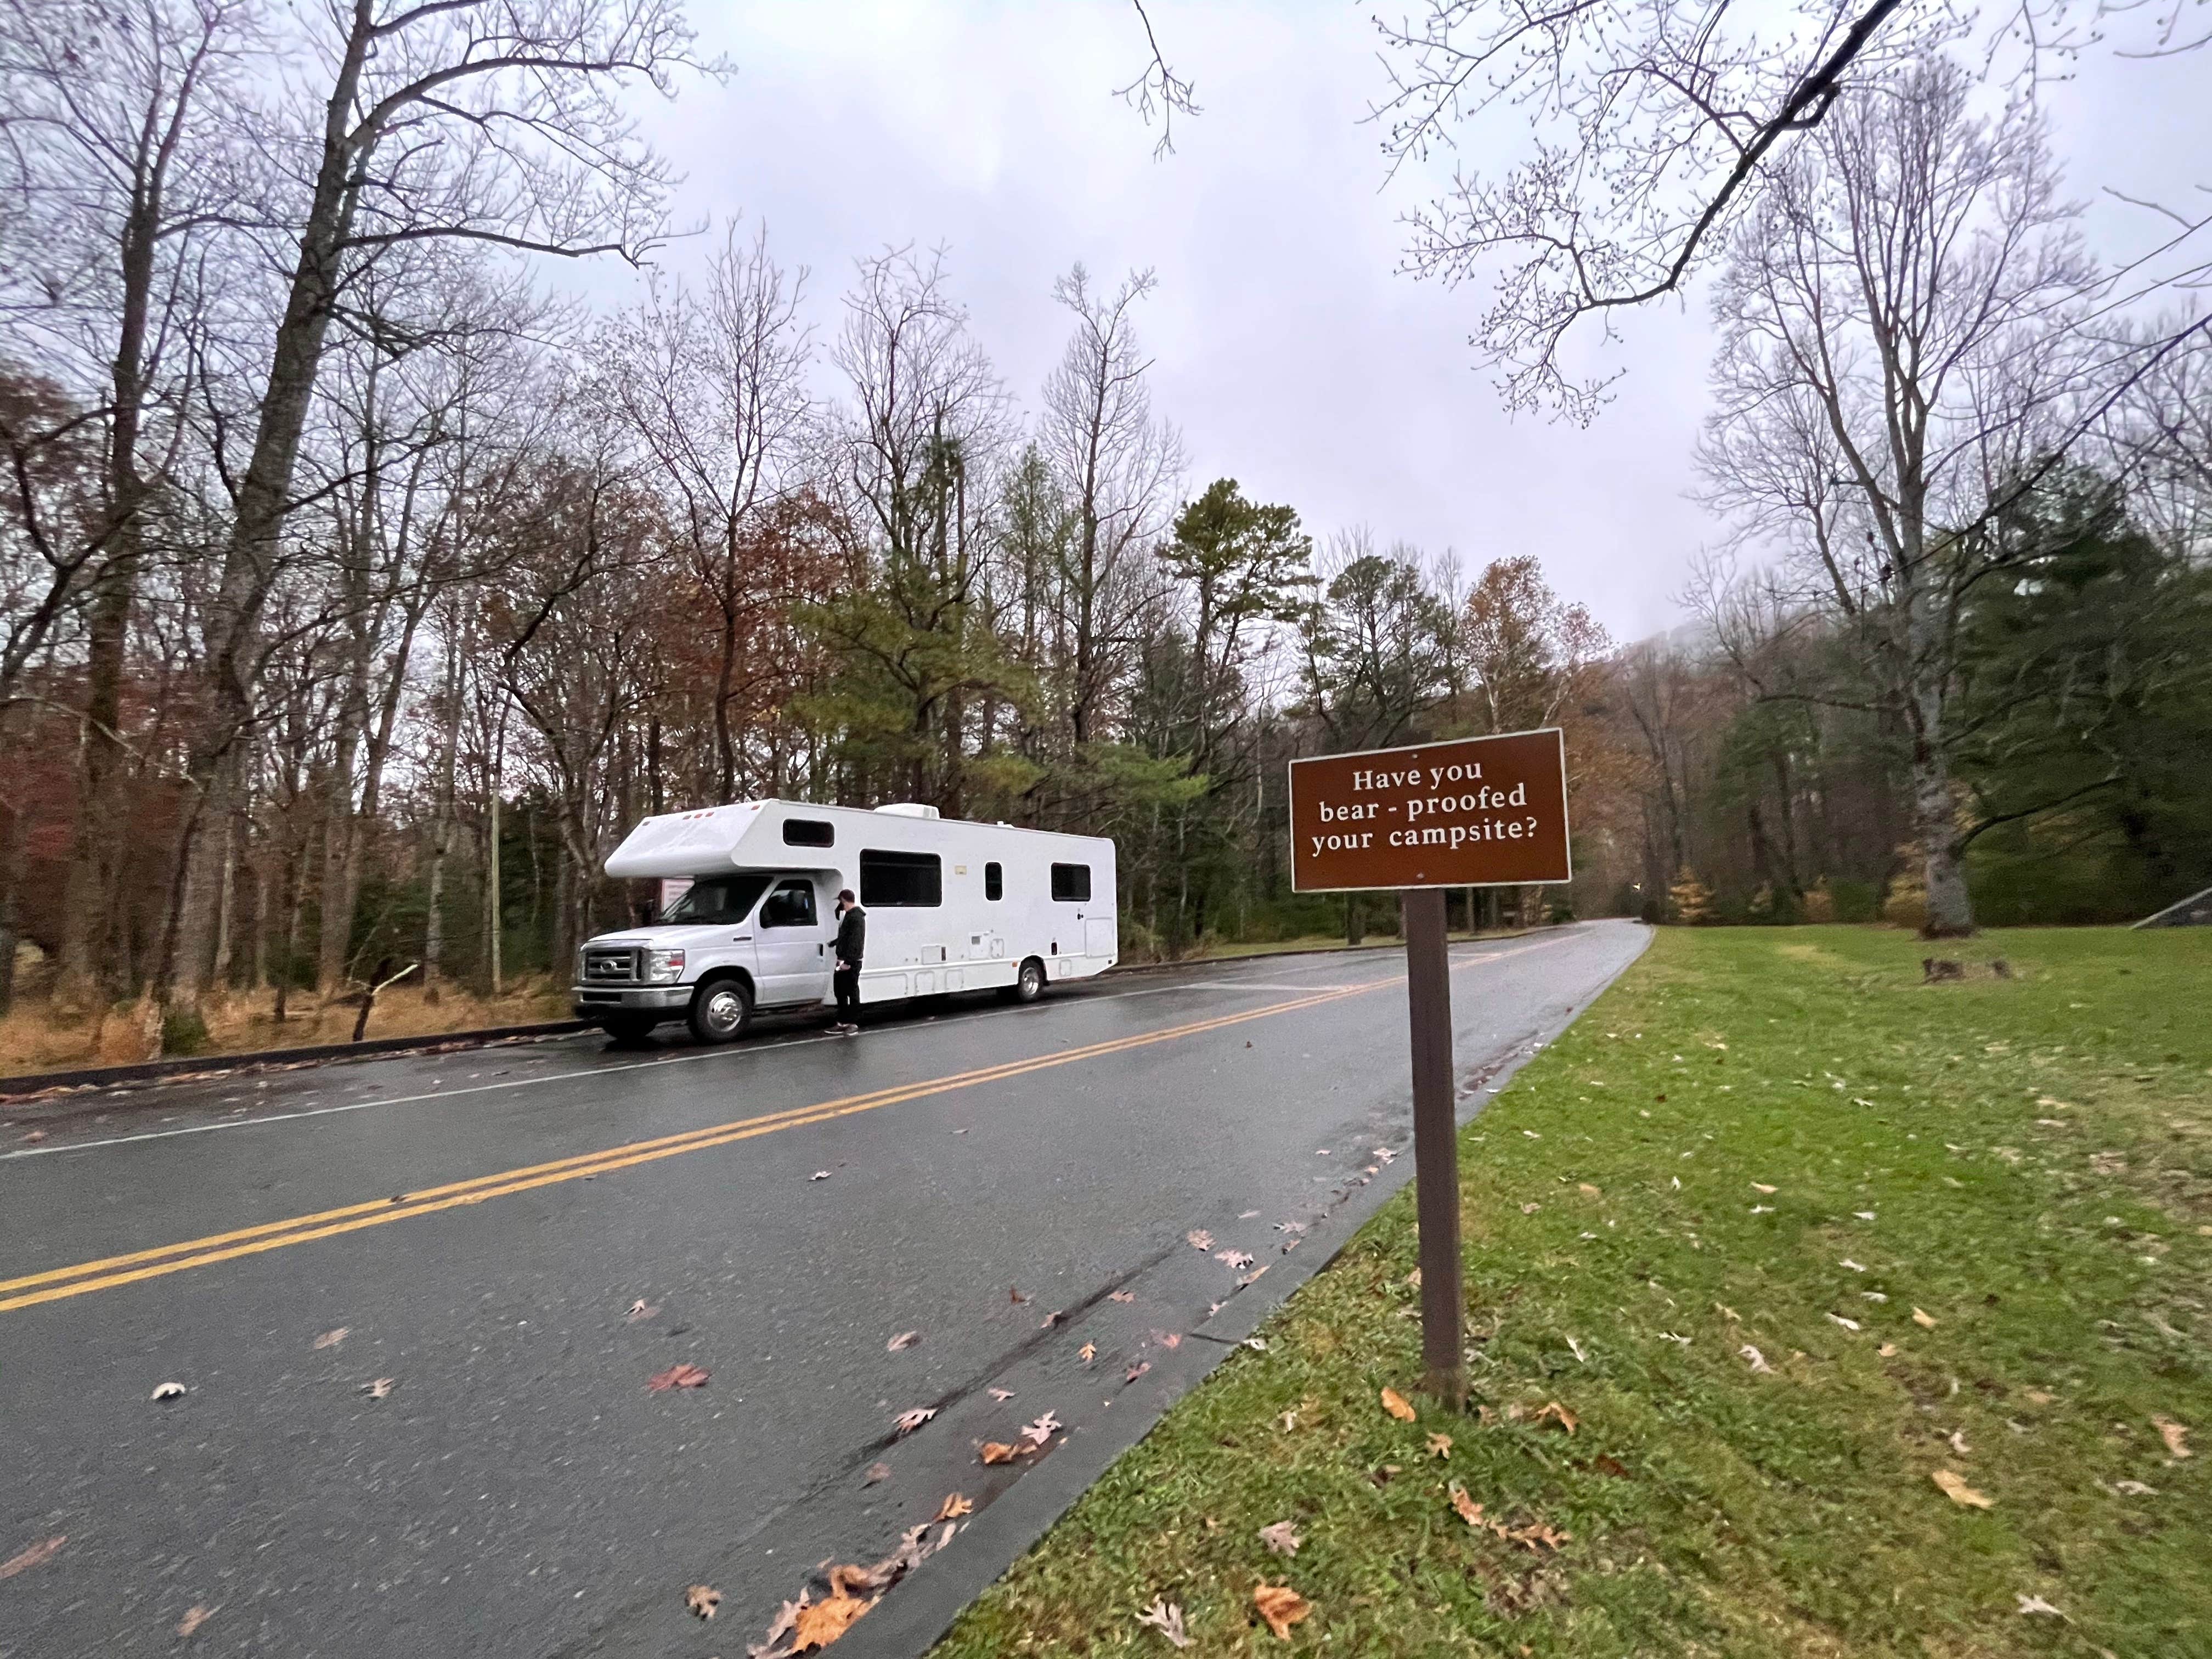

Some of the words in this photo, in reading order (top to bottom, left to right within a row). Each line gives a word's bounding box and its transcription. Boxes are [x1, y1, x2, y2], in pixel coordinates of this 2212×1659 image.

[1352, 770, 1421, 791] Have
[1430, 763, 1482, 790] you
[1319, 801, 1379, 822] bear
[1407, 782, 1527, 822] proofed
[1311, 833, 1373, 857] your
[1389, 816, 1537, 849] campsite?
